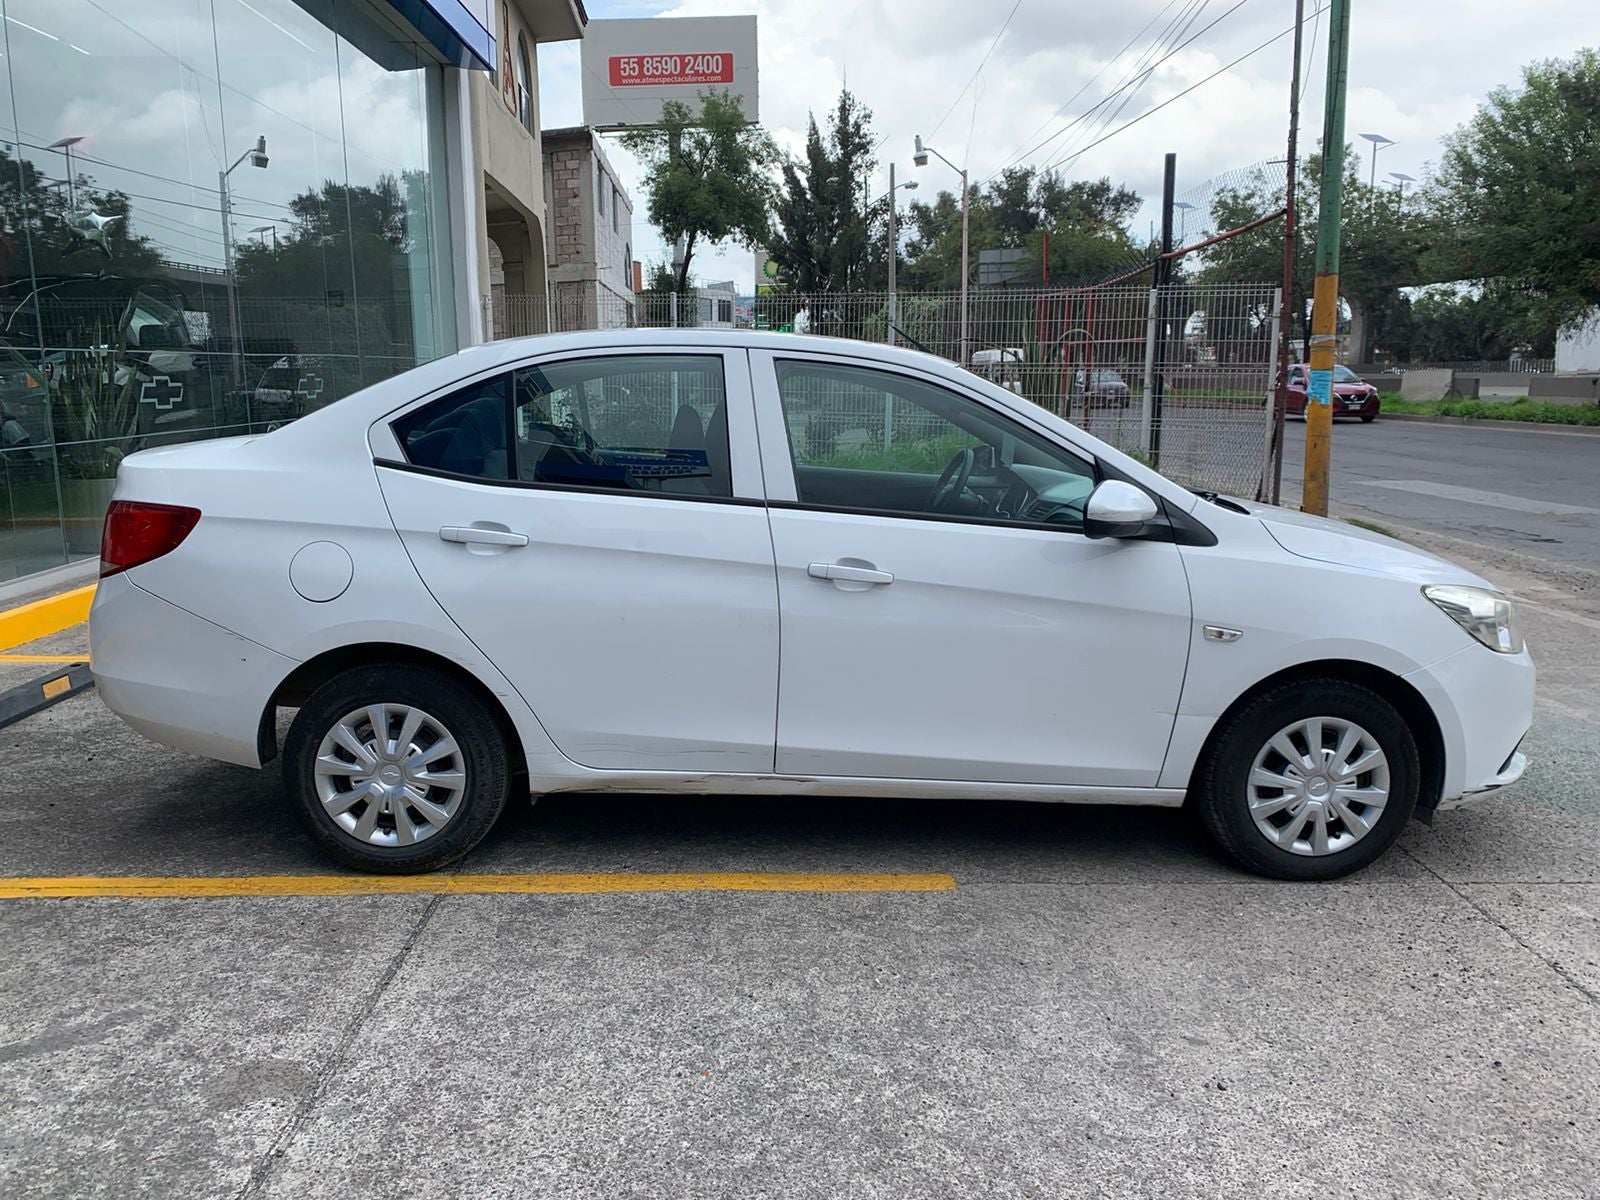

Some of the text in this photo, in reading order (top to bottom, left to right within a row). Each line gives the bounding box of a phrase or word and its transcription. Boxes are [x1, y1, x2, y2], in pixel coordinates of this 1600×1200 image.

[620, 55, 722, 76] 55 8590 2400
[621, 75, 722, 84] www.atmespectaculares.com
